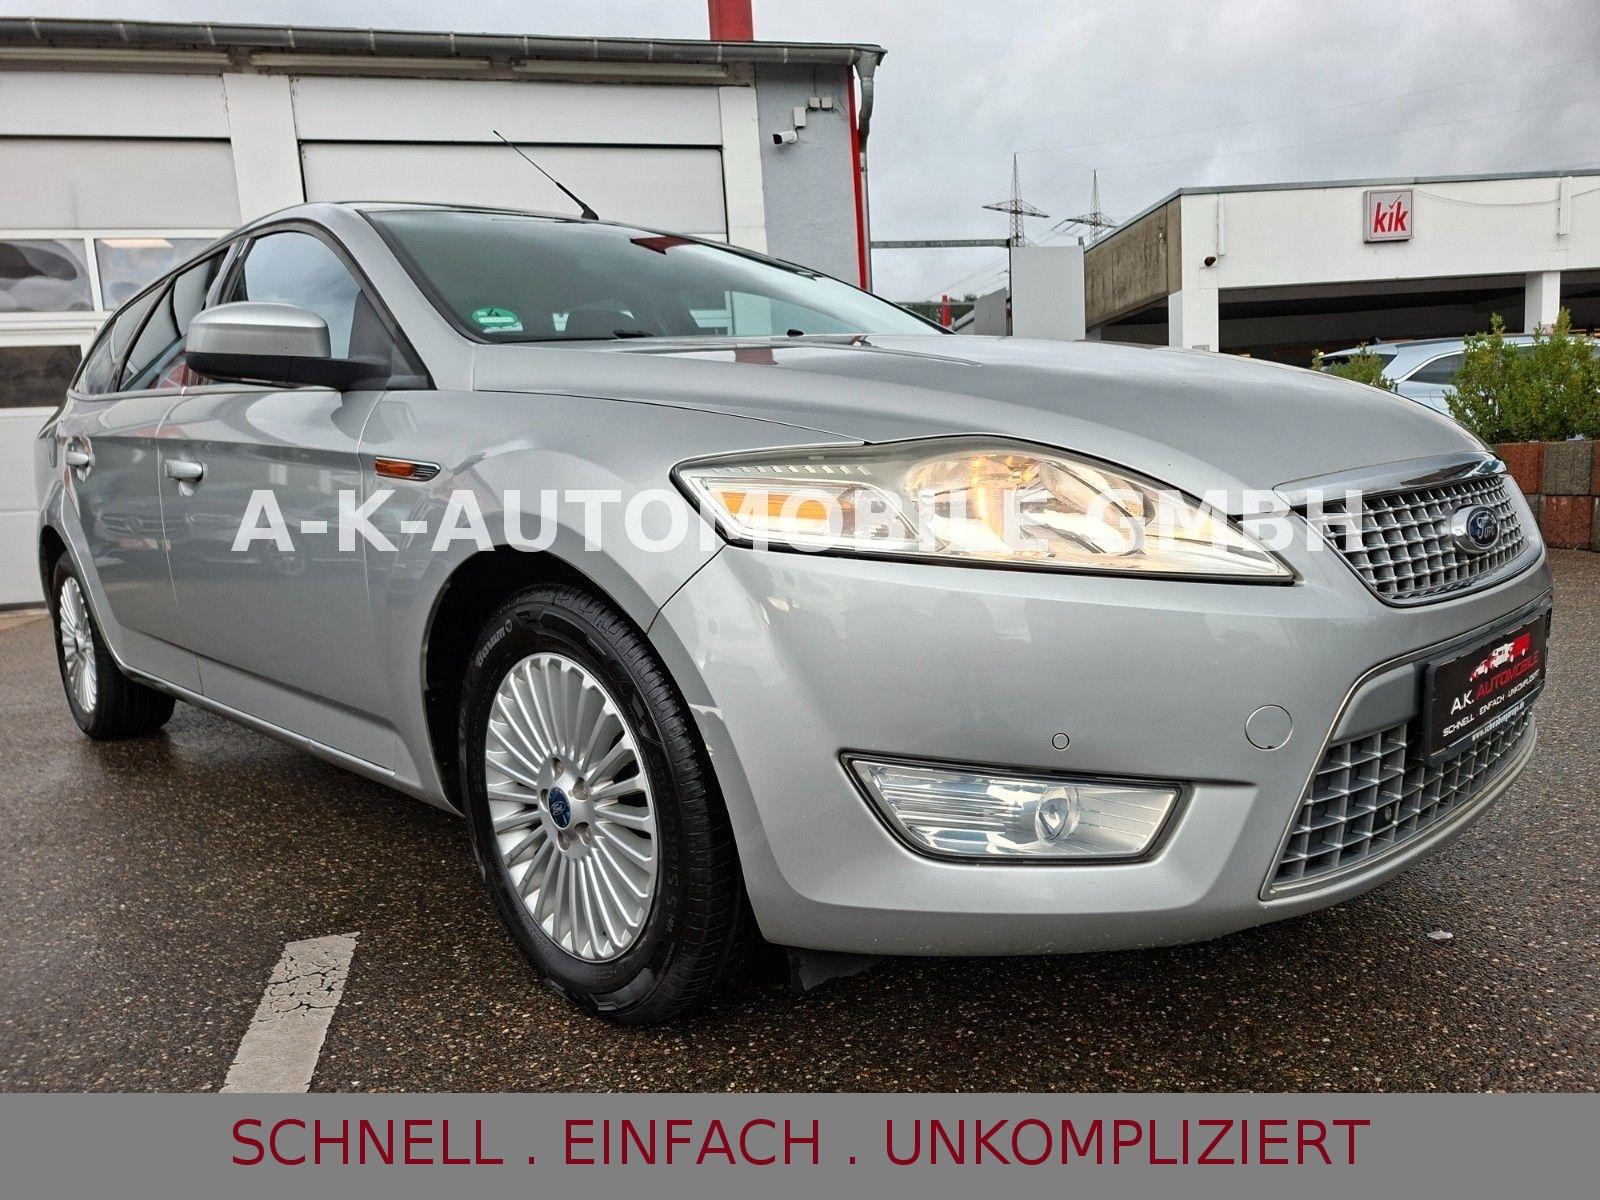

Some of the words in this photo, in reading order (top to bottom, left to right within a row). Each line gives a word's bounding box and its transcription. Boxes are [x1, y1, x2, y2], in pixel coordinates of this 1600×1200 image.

[1451, 689, 1475, 715] A.K.
[1475, 650, 1540, 700] AUTOMOBILE
[1442, 713, 1475, 737] SCHNELL
[1479, 692, 1505, 716] EINFACH
